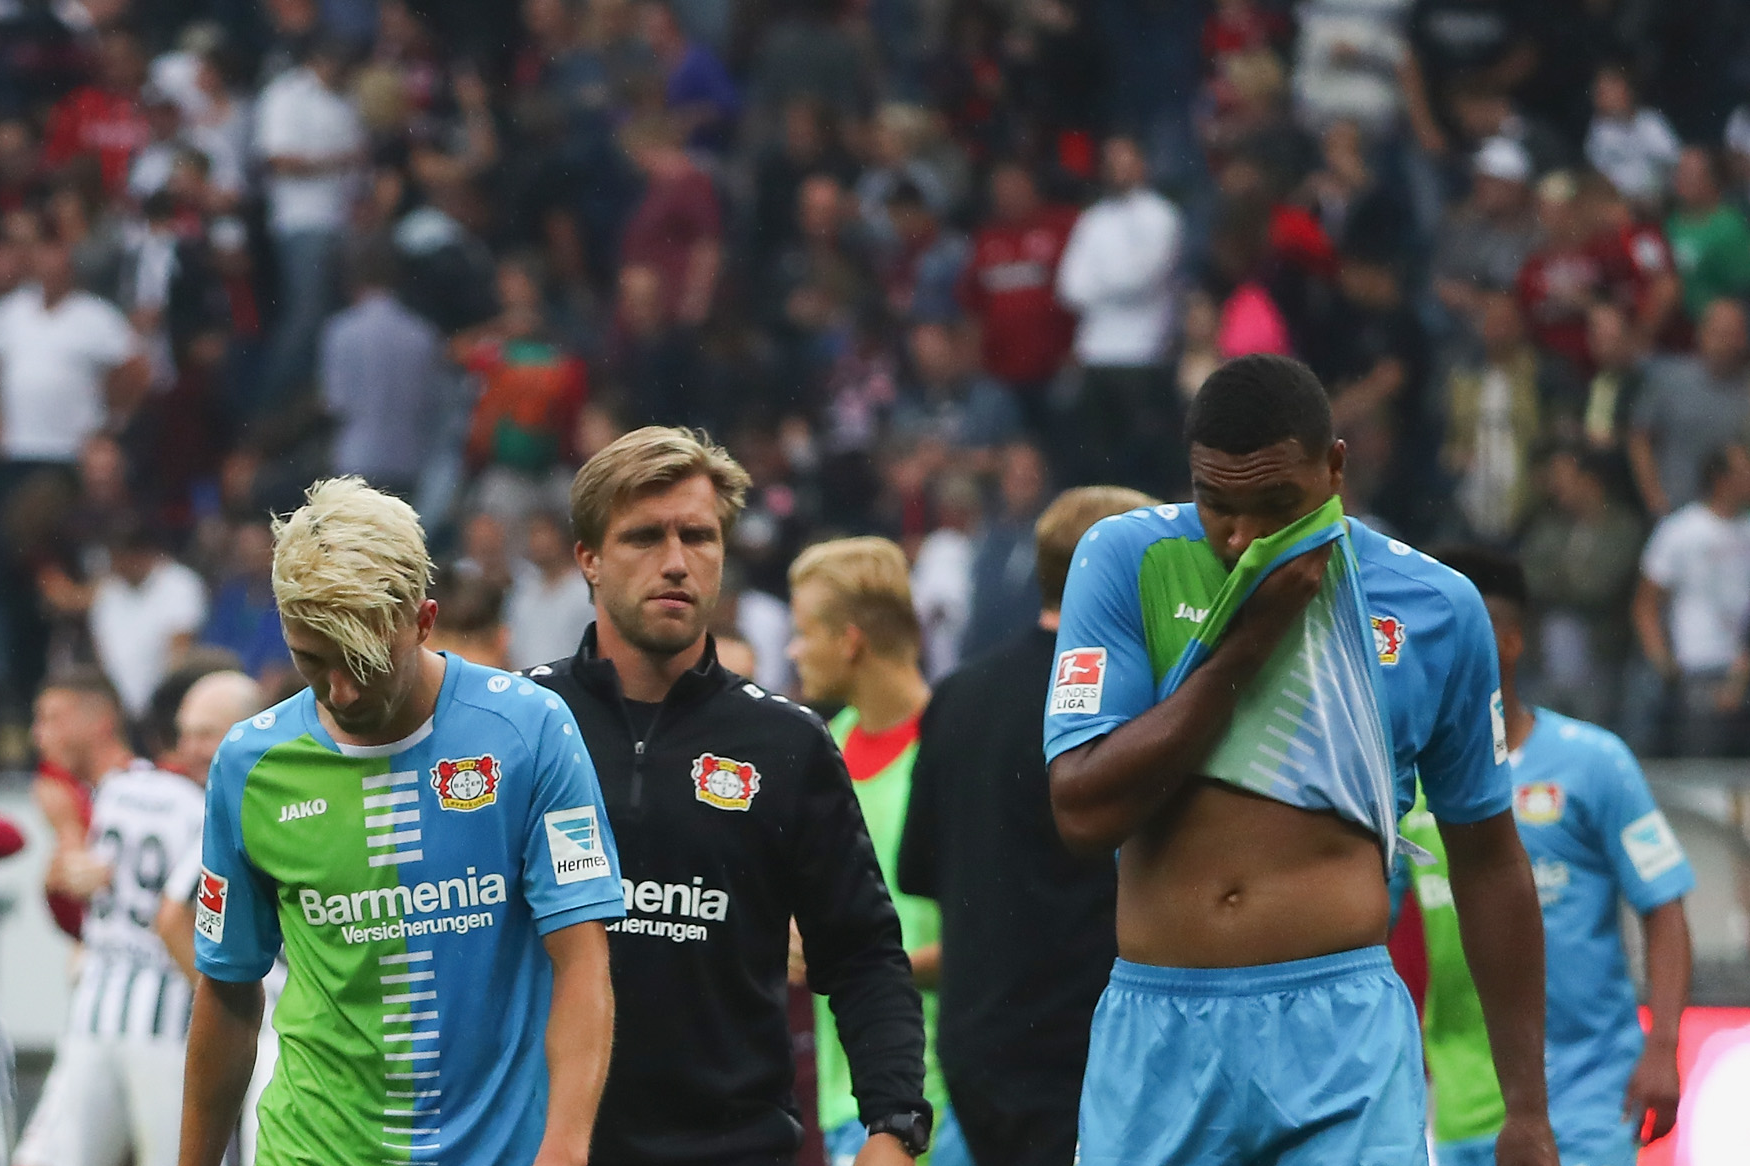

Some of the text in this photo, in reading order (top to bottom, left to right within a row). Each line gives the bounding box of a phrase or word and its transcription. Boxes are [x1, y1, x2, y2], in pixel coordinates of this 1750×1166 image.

[1054, 687, 1097, 700] BUNDES
[1057, 699, 1086, 710] LIGA
[278, 797, 328, 823] JAKO
[557, 855, 606, 874] Hermes
[299, 866, 508, 926] Barmenia
[340, 911, 493, 945] Versicherungen
